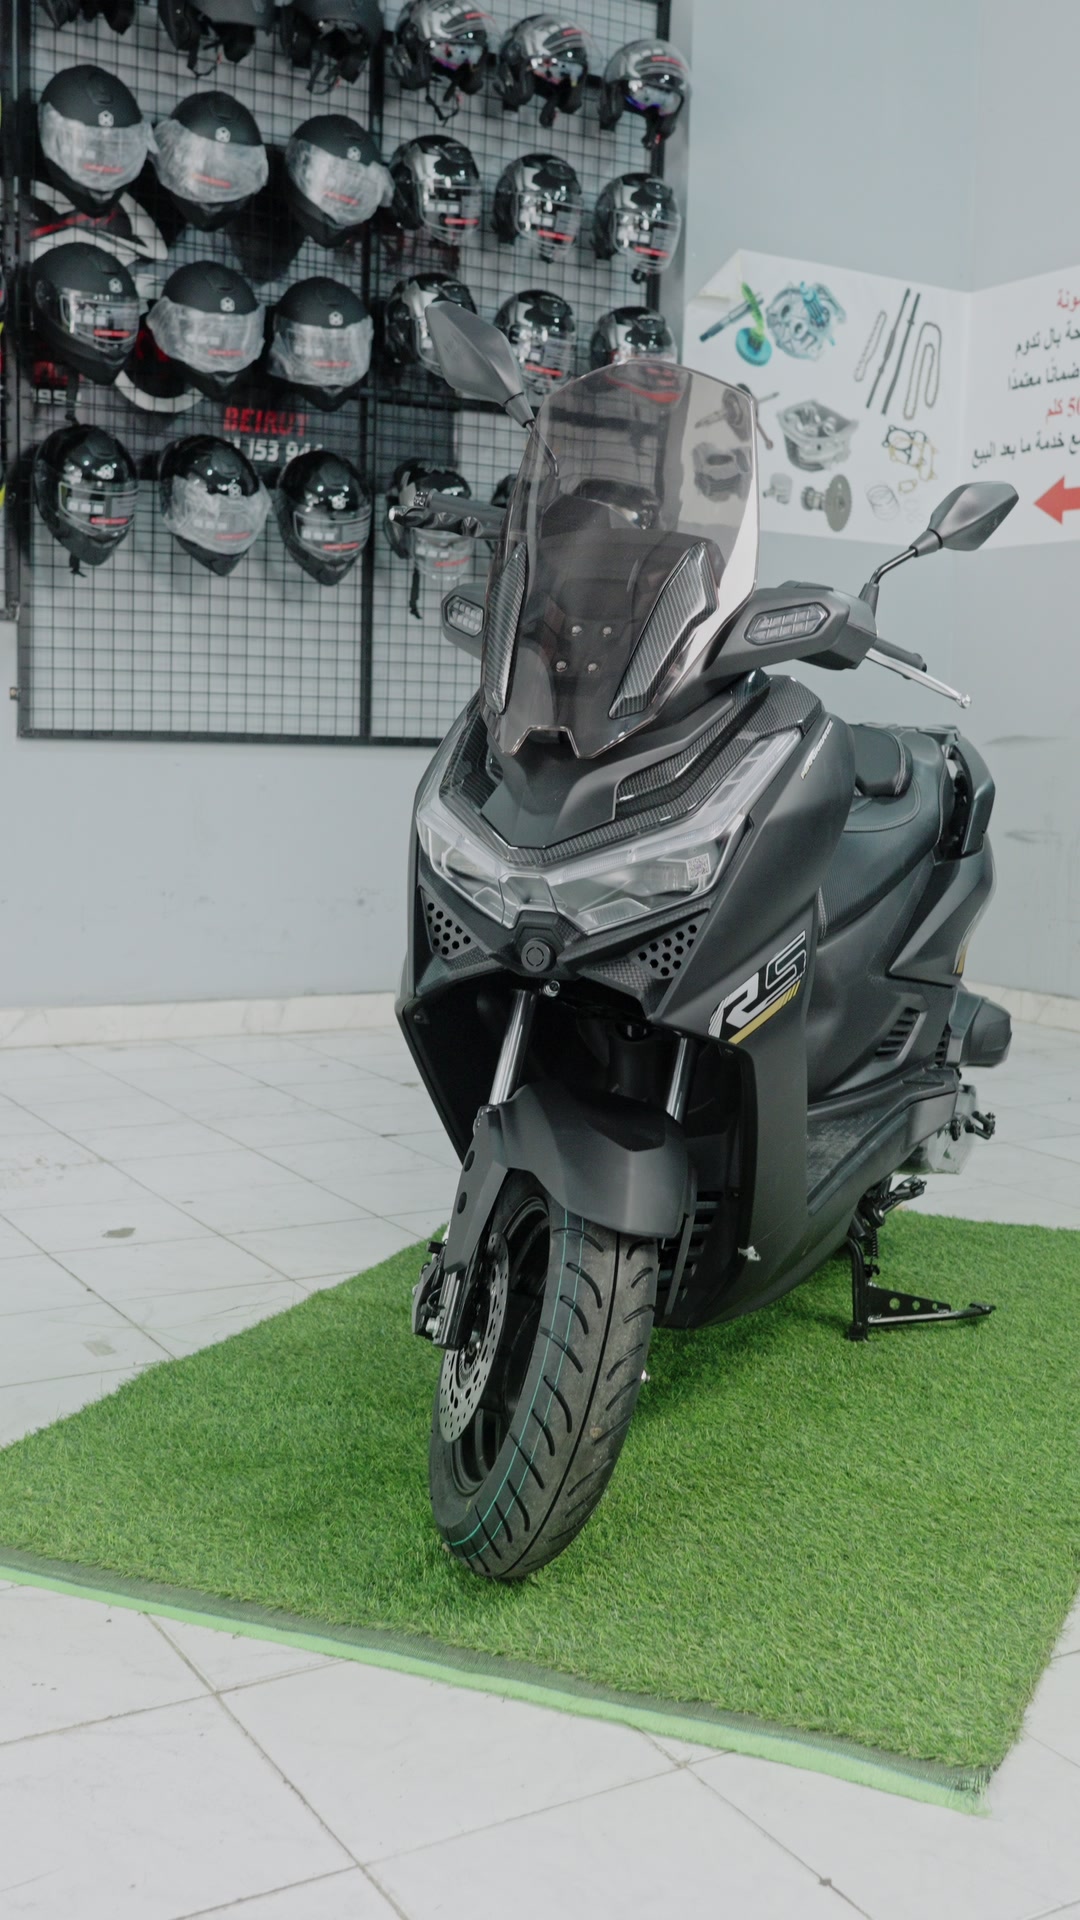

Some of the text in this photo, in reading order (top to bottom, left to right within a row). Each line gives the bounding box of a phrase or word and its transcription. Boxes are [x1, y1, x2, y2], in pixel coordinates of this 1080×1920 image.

[1015, 331, 1040, 359] تدوم
[223, 406, 311, 437] BEIRUT
[1045, 398, 1063, 425] كلم
[247, 438, 280, 462] 153
[1000, 443, 1016, 461] بعد
[1020, 437, 1031, 453] ما
[1035, 430, 1065, 450] خدمة
[972, 440, 996, 469] البيع
[708, 930, 807, 1039] RS
